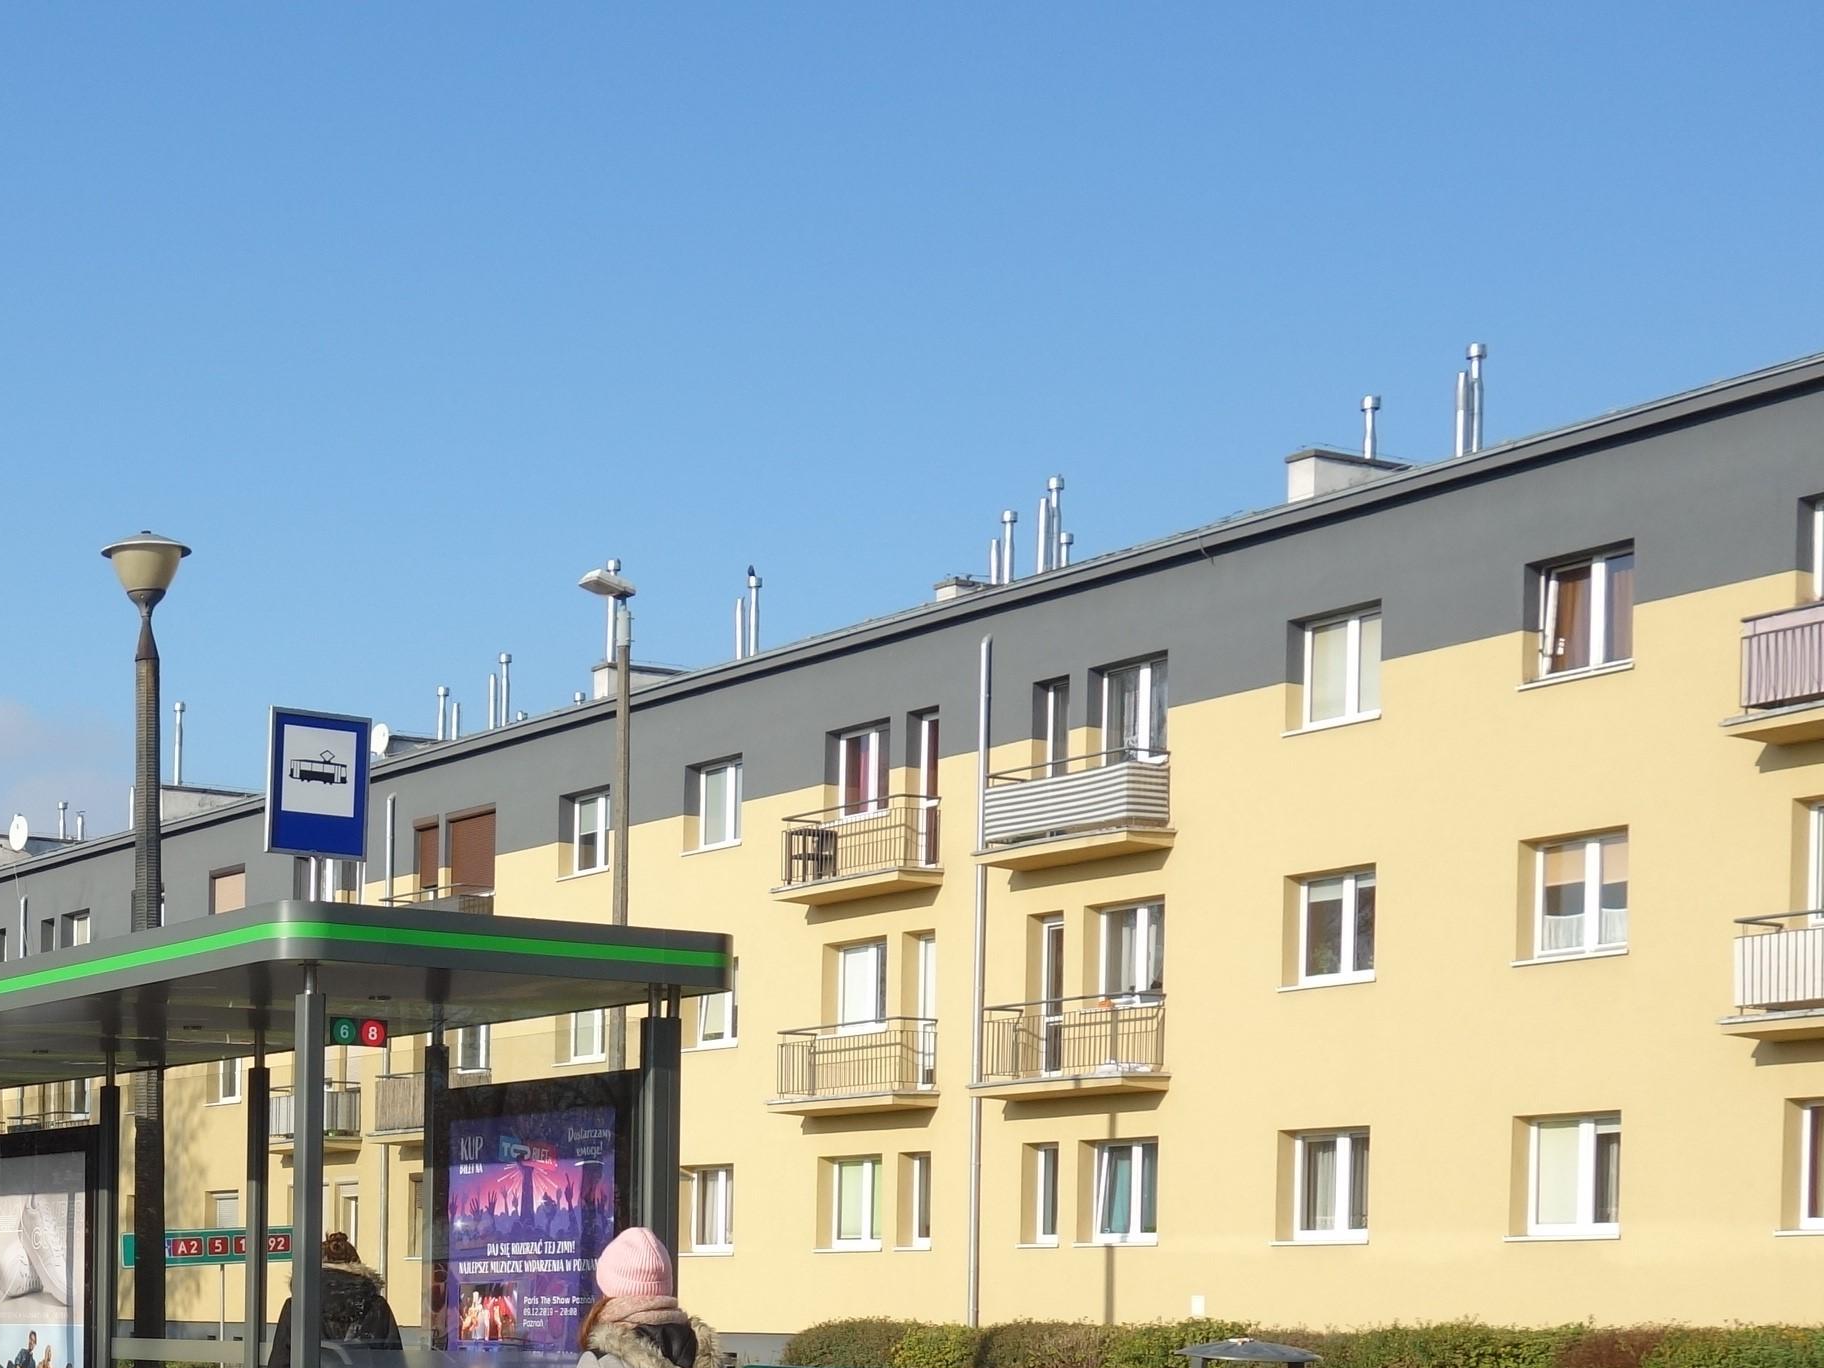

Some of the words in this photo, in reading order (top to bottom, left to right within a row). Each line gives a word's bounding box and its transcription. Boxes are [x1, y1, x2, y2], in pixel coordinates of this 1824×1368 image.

[340, 1024, 350, 1039] 6
[368, 1026, 378, 1041] 8
[567, 1128, 611, 1143] Dostarczamy
[460, 1135, 484, 1161] KUP
[177, 1239, 199, 1255] A2
[214, 1238, 223, 1253] 5
[267, 1236, 286, 1251] 92
[487, 1242, 499, 1257] DAJ
[499, 1241, 511, 1258] SIĘ
[511, 1239, 543, 1256] ROZGRZAĆ
[544, 1241, 555, 1255] TEJ
[556, 1240, 576, 1255] ZIMY!
[458, 1260, 489, 1275] NAJLEPSZE
[490, 1259, 523, 1274] MUZYCZNE
[524, 1259, 565, 1273] WYDARZENIA
[565, 1259, 573, 1272] W
[540, 1295, 552, 1305] The
[552, 1295, 570, 1305] Show
[523, 1307, 554, 1317] 09.12.2019
[522, 1319, 544, 1328] Poznań
